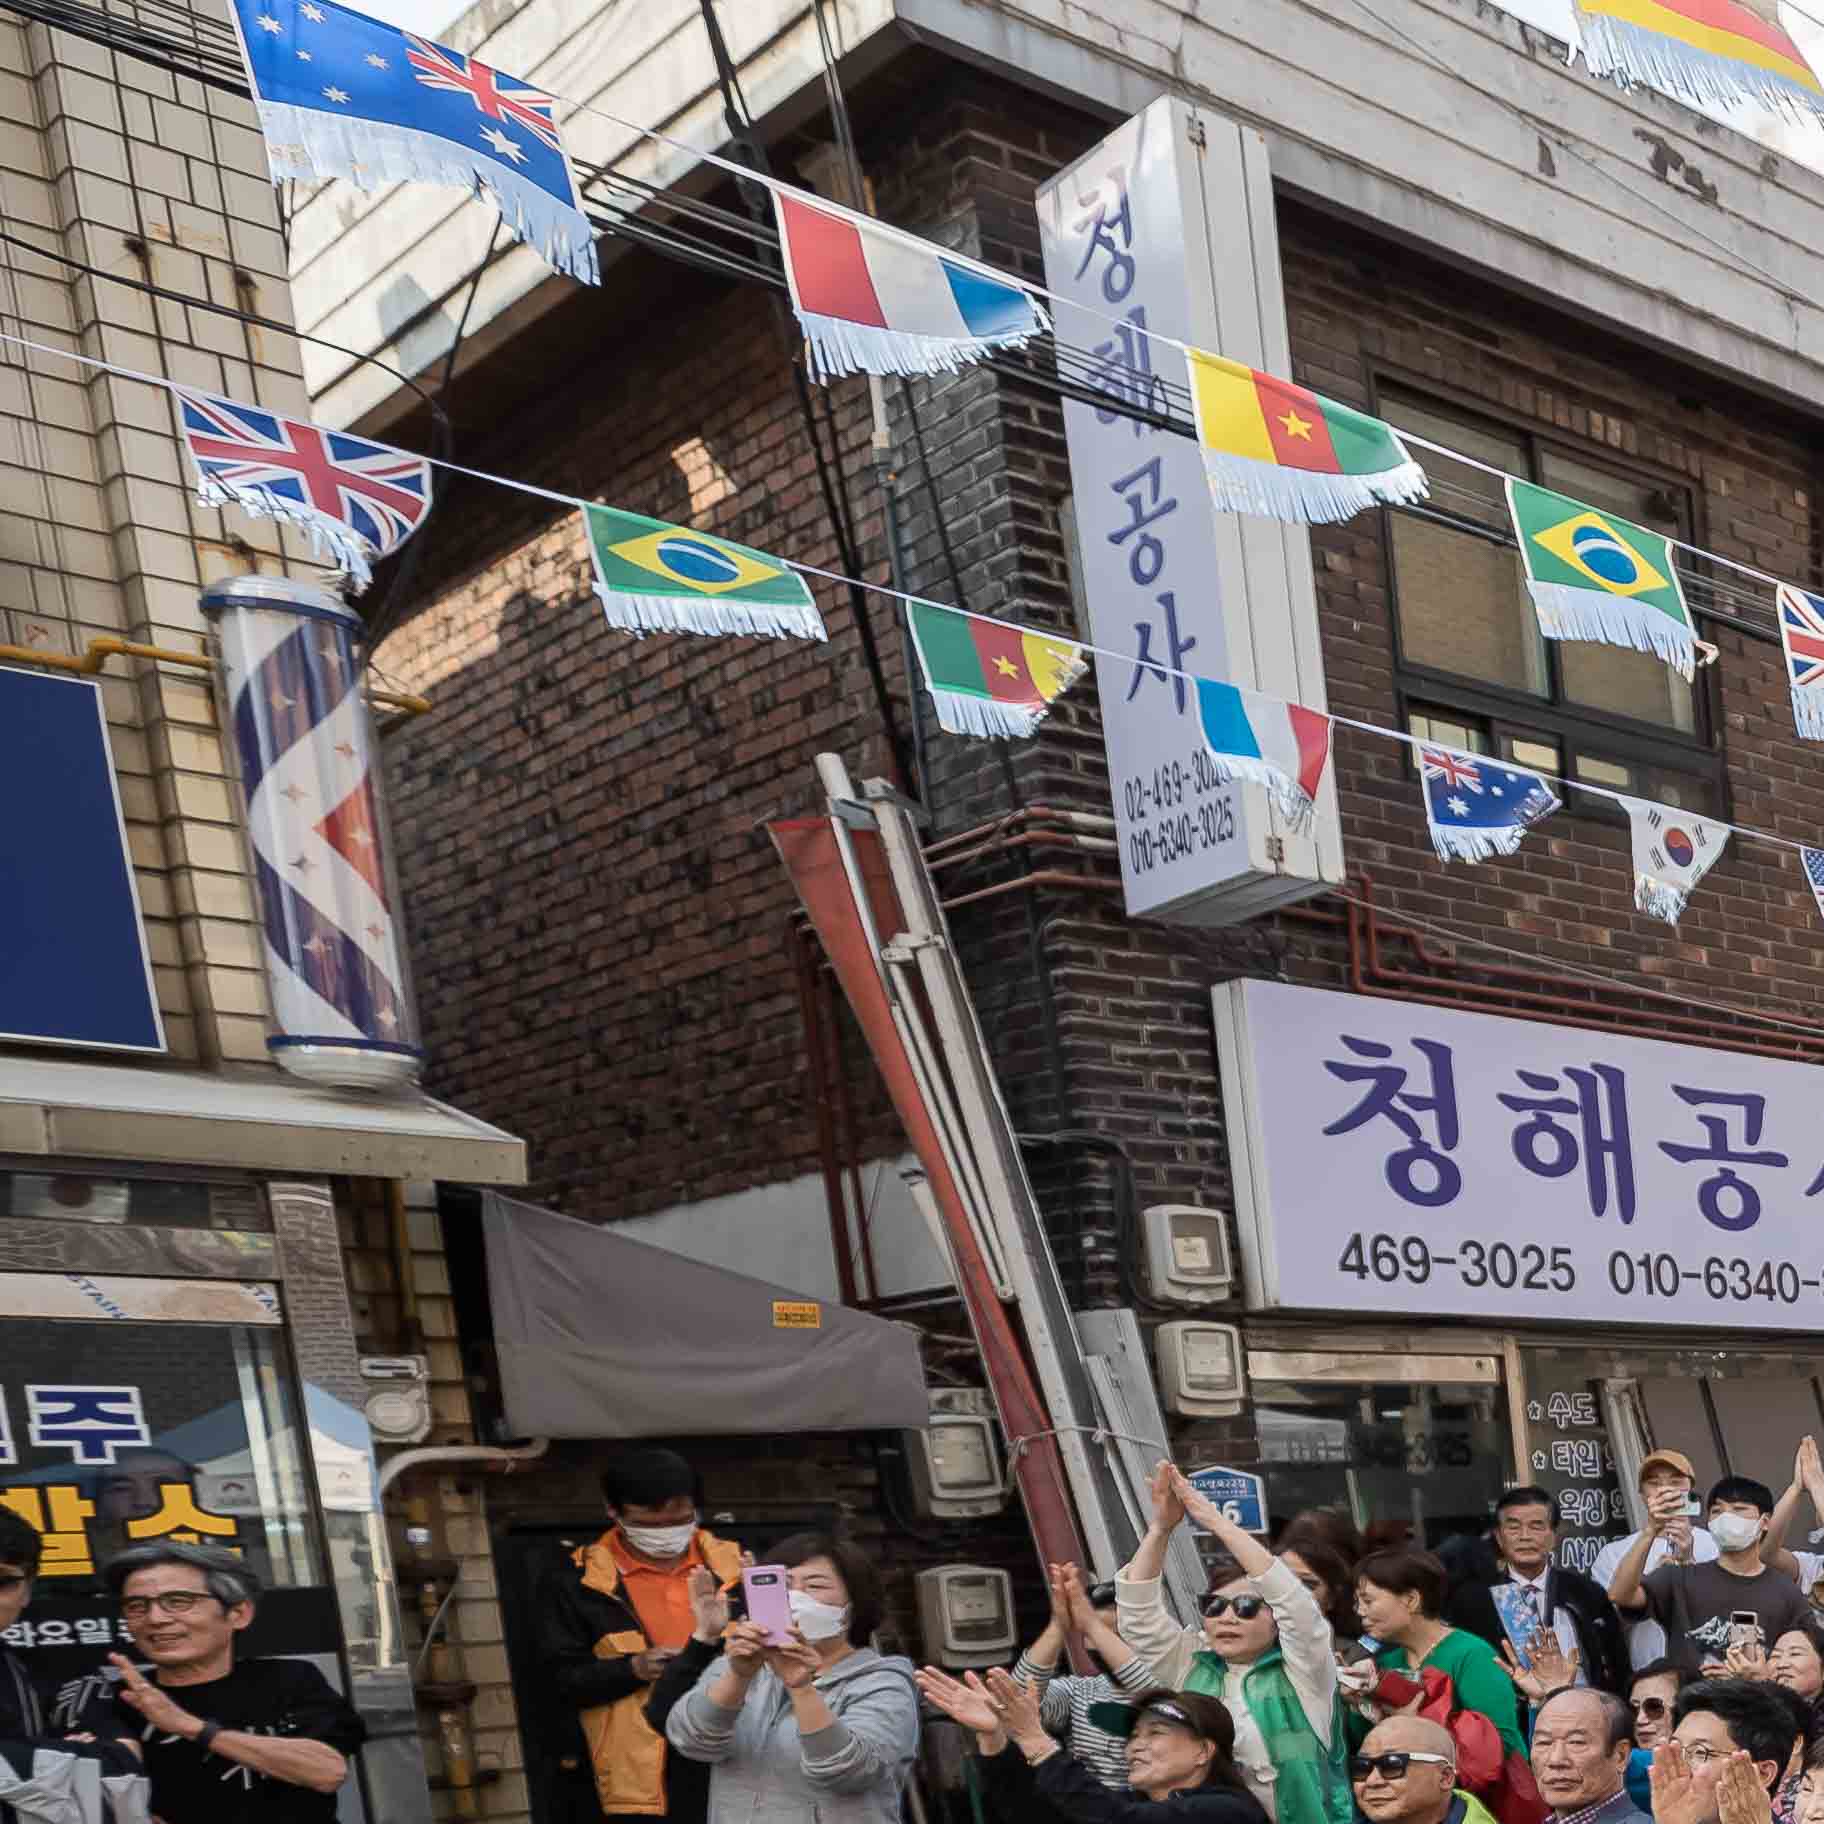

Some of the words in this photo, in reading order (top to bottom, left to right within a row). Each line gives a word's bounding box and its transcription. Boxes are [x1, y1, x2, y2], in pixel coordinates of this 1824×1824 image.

[1074, 170, 1197, 716] 청해공사
[1128, 795, 1234, 875] 010-6340-3025
[1339, 1231, 1577, 1294] 469-3025
[0, 1383, 151, 1465] 주
[1547, 1391, 1597, 1429] 수도
[1551, 1439, 1601, 1479] 타일
[1558, 1488, 1605, 1527] 옥상
